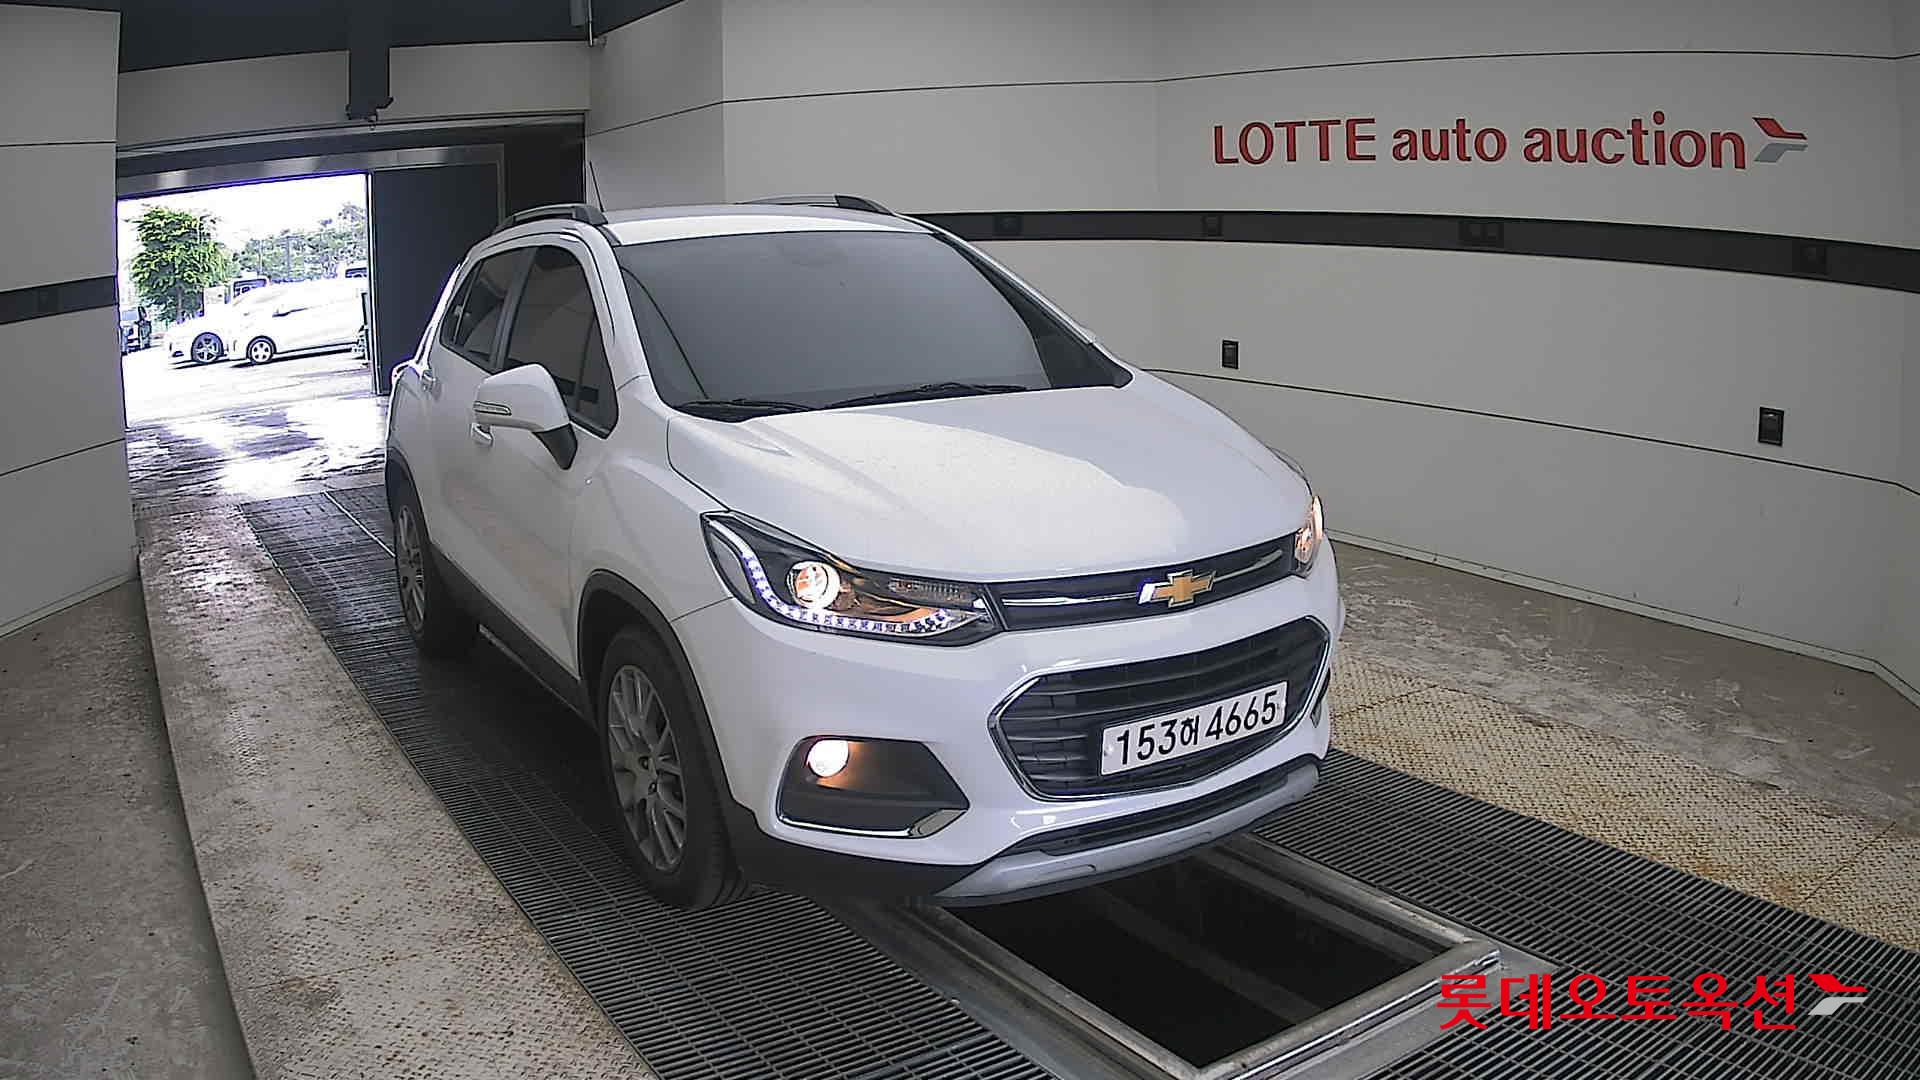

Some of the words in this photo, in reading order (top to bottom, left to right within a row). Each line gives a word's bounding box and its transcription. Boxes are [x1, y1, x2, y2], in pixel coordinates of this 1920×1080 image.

[1213, 117, 1376, 164] LOTTE
[1392, 118, 1507, 163] auto
[1523, 111, 1747, 170] auction
[1116, 714, 1200, 765] 153허
[1205, 690, 1278, 740] 4665
